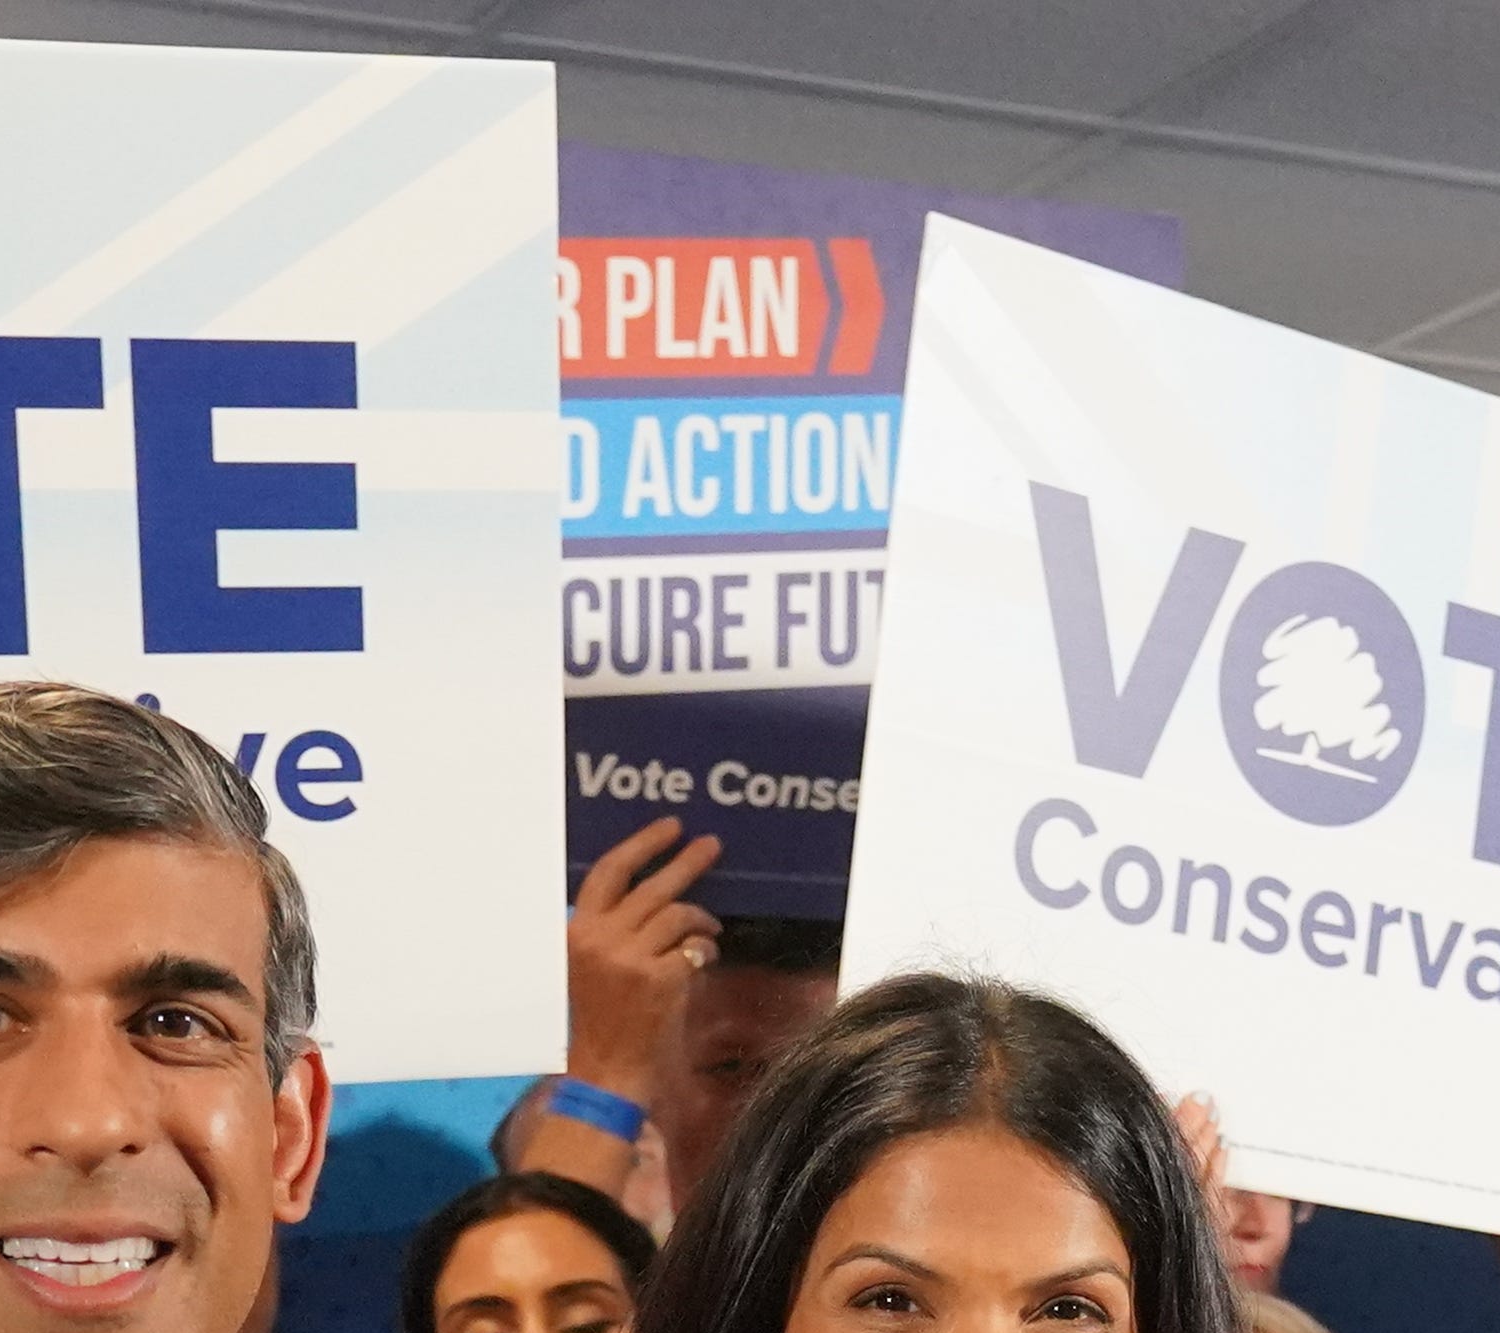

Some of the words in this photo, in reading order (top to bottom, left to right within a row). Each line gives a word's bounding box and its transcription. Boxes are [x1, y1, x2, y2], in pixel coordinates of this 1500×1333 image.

[606, 256, 800, 359] PLAN
[621, 412, 890, 519] ACTION
[575, 752, 694, 803] Vote
